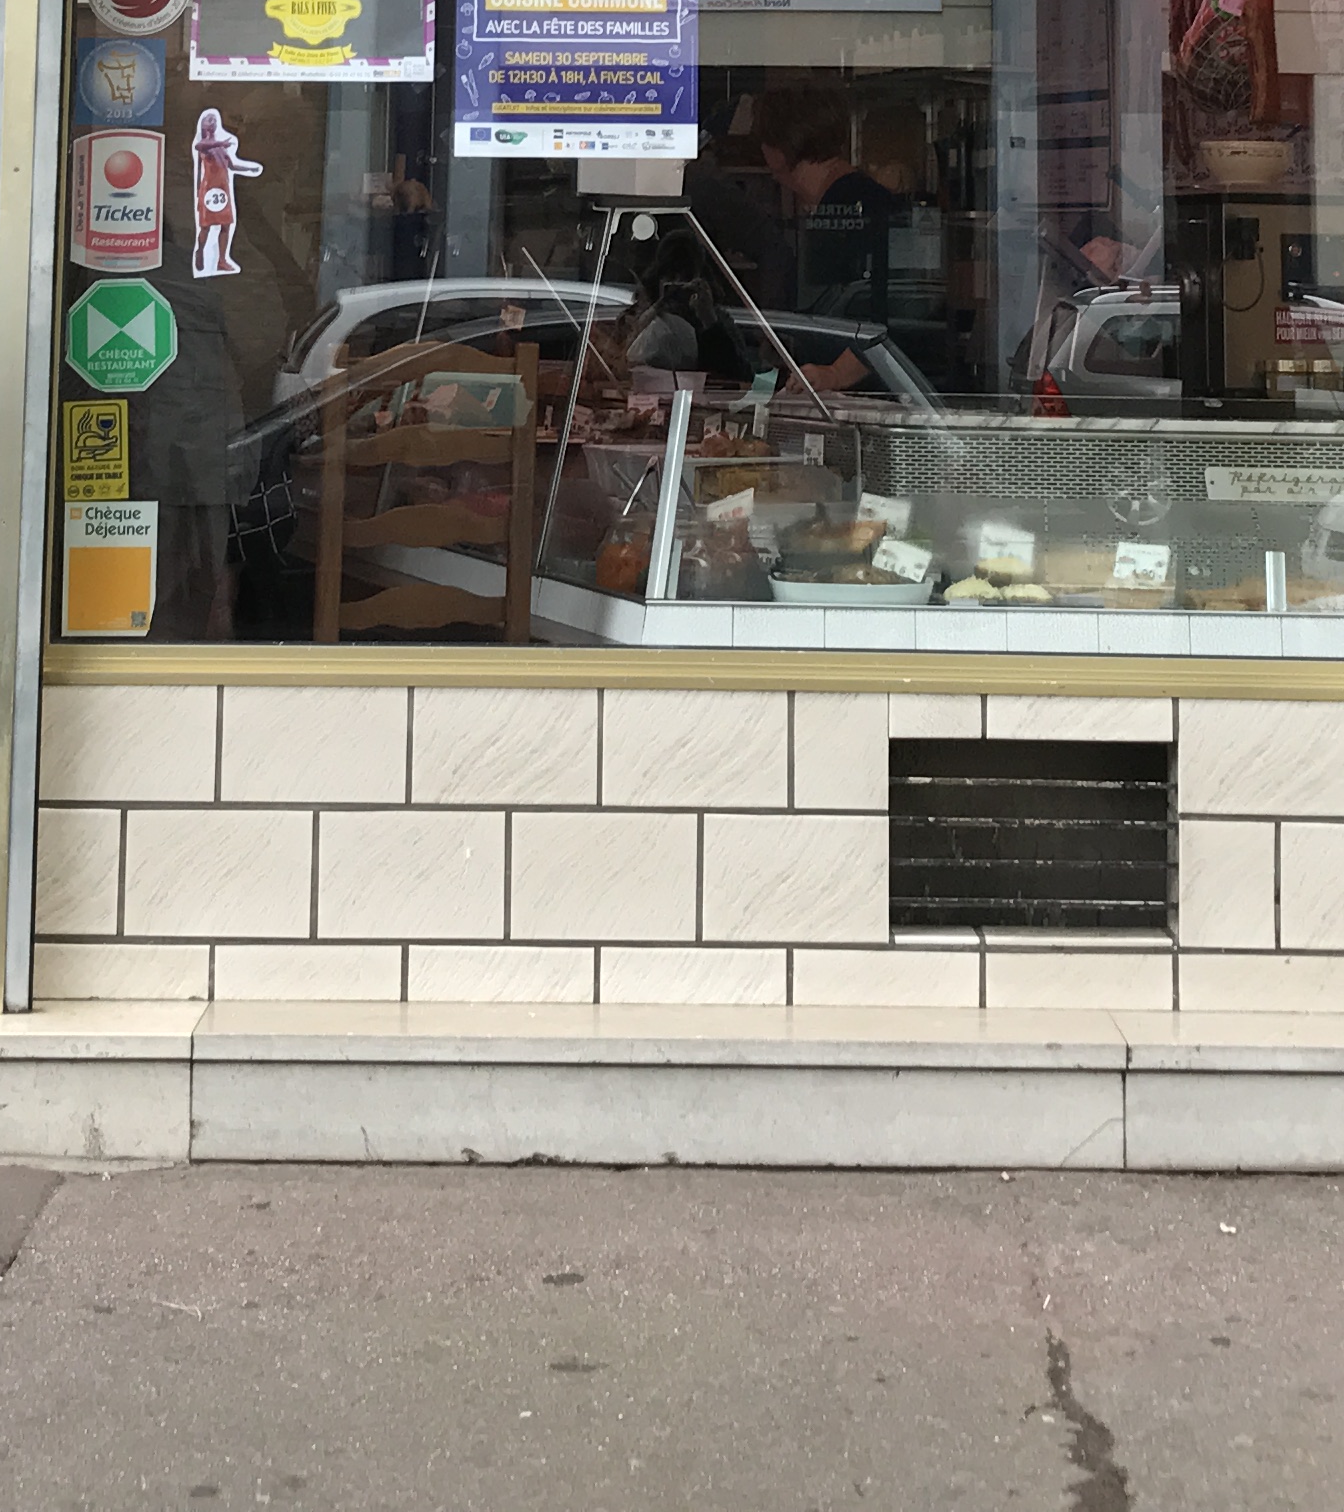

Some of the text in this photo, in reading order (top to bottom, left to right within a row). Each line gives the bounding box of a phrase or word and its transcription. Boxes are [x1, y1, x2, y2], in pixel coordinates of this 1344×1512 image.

[485, 17, 670, 36] AVEC LA FÊTE DES FAMILLES
[505, 51, 648, 66] SAMEDI 30 SEPTEMBRE
[489, 67, 664, 86] DE 12H30 À 18H, À FIVES CAIL
[106, 108, 133, 119] 2013
[212, 193, 226, 204] 33
[93, 204, 154, 222] Ticket
[98, 346, 144, 360] CHÈQUE
[87, 359, 156, 371] RESTAURANT
[85, 506, 142, 523] Chèque
[85, 522, 151, 538] Déjeuner
